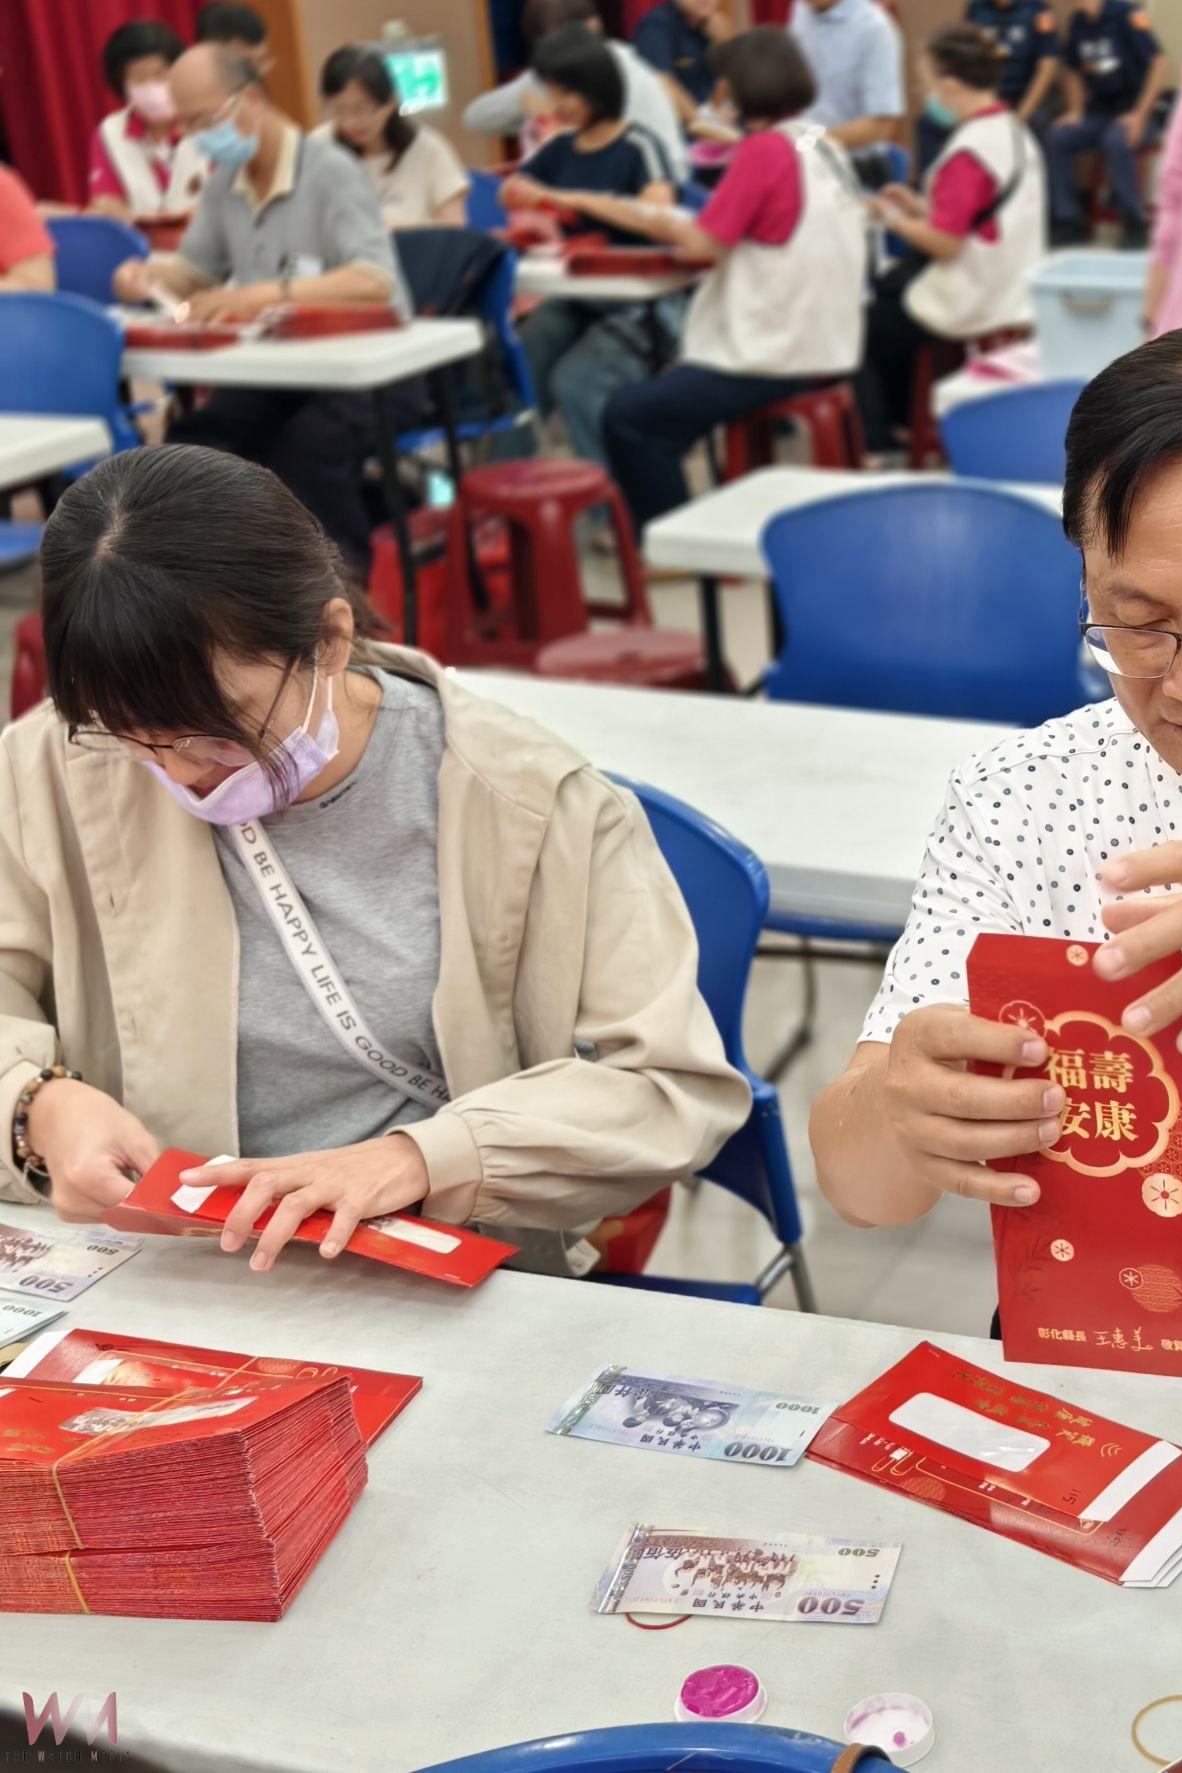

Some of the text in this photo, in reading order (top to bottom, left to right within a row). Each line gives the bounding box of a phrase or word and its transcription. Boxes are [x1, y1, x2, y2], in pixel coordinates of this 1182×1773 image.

[253, 851, 276, 878] BE
[269, 883, 318, 958] HAPPY
[310, 964, 342, 1005] LIFE
[336, 1009, 357, 1031] IS
[355, 1035, 408, 1079] GOOD
[408, 1073, 431, 1091] BE
[1044, 1048, 1135, 1093] 福壽
[86, 1244, 119, 1256] 500
[18, 1275, 74, 1293] 500
[2, 1304, 43, 1317] 1000
[774, 1401, 821, 1415] 1000
[639, 1434, 702, 1452] 中華民國
[723, 1441, 794, 1463] 1000
[837, 1548, 880, 1557] 500
[691, 1597, 765, 1613] 中華民國
[796, 1596, 866, 1616] 500
